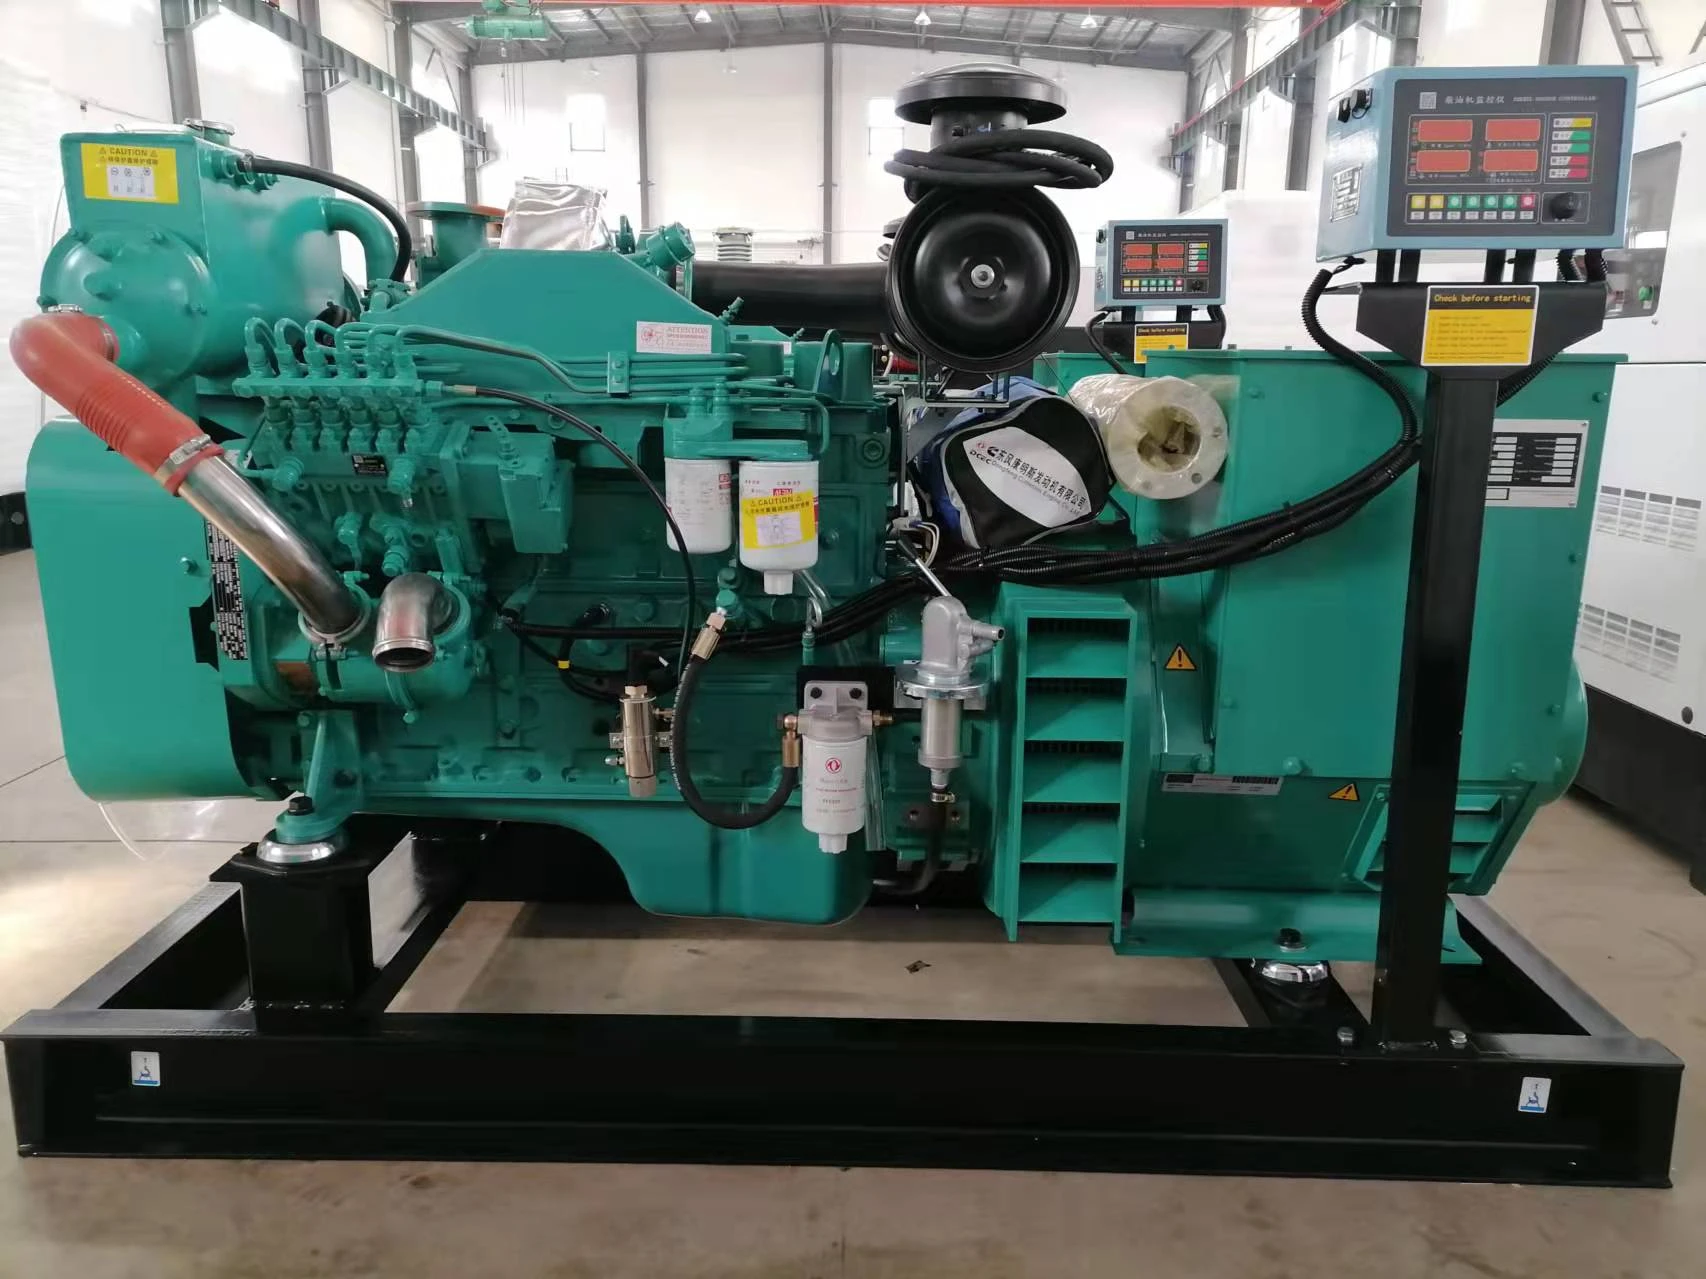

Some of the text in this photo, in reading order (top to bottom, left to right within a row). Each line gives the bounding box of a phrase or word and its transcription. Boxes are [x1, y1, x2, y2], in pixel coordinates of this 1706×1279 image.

[109, 147, 148, 157] CAUTION
[1434, 293, 1532, 304] Check before starting
[997, 448, 1087, 511] 东风康明斯发动机有限公司
[758, 496, 794, 506] CAUTION
